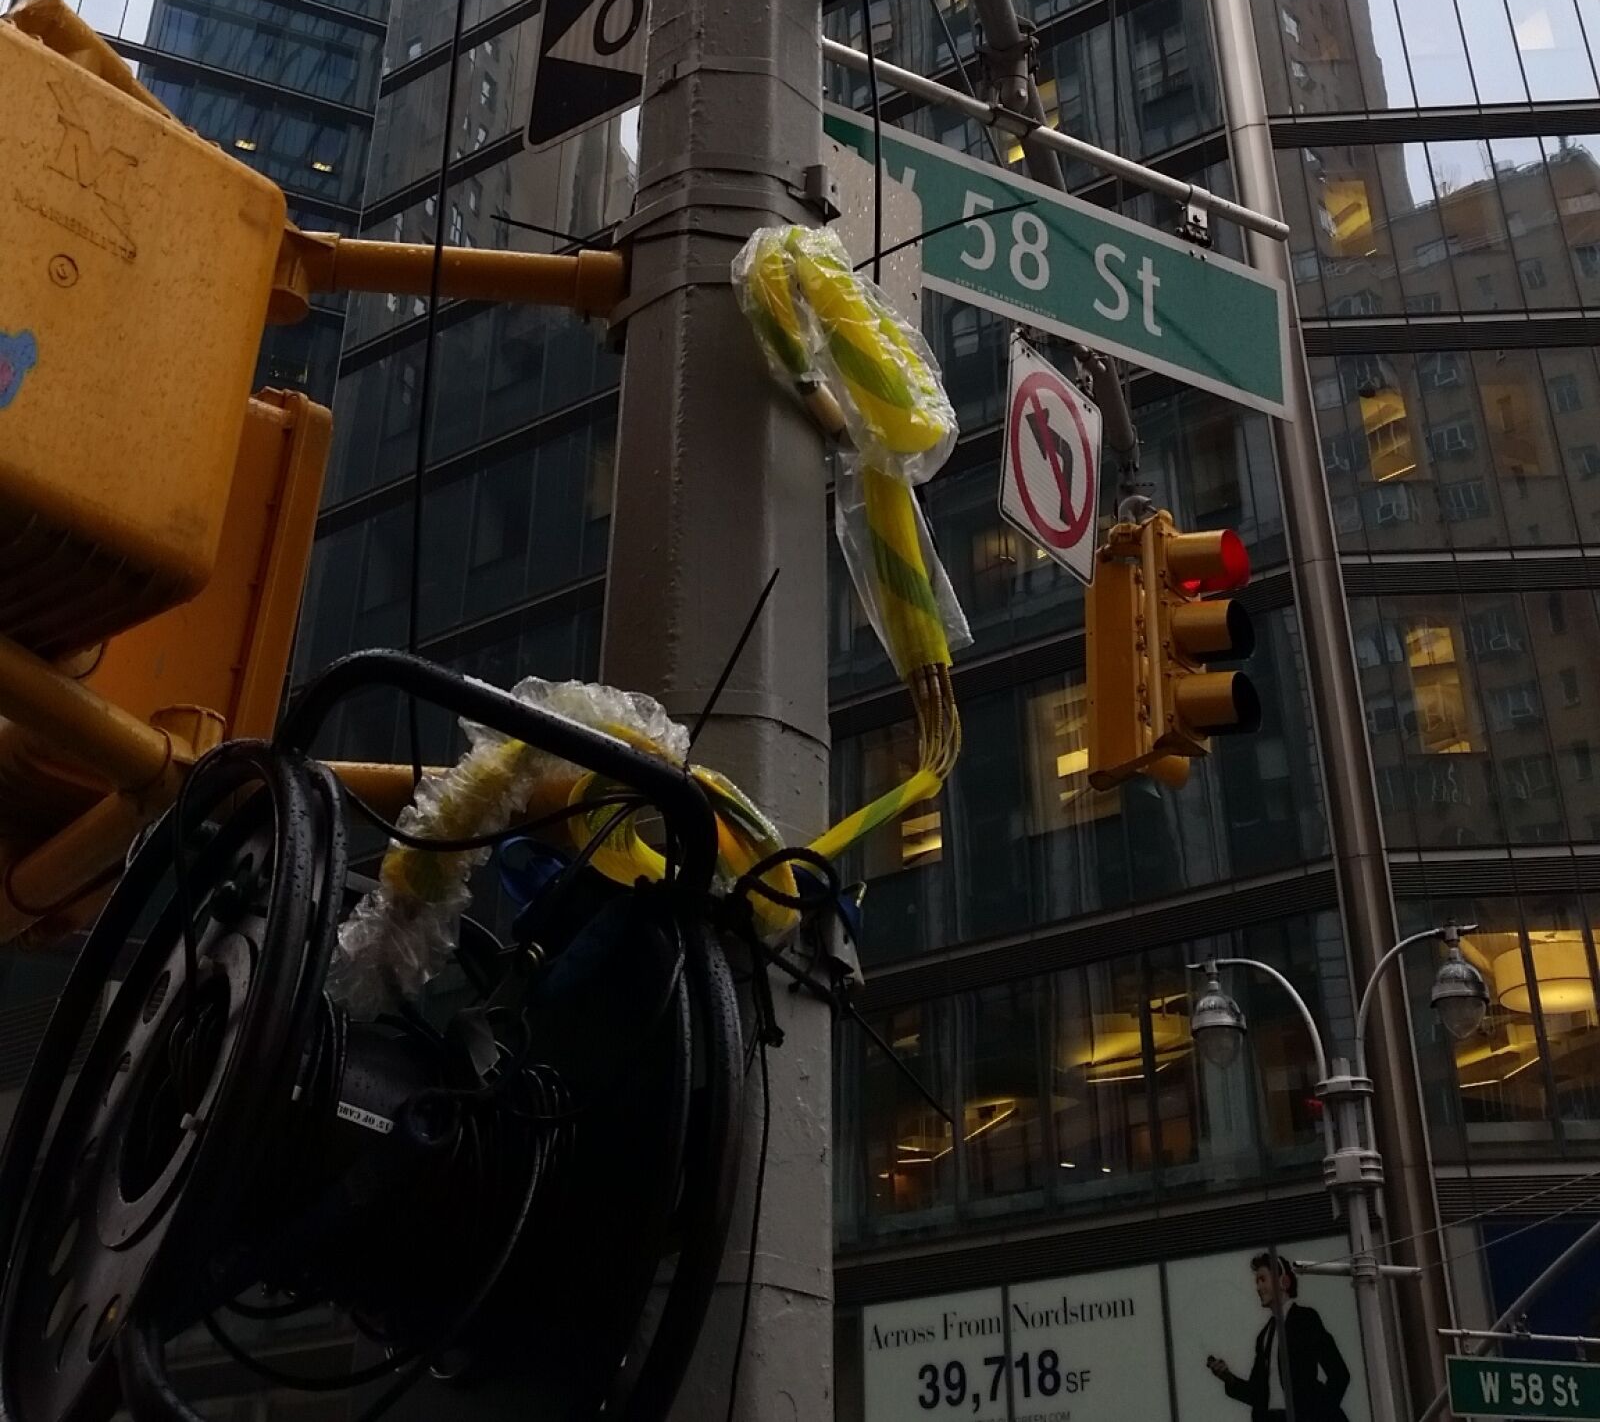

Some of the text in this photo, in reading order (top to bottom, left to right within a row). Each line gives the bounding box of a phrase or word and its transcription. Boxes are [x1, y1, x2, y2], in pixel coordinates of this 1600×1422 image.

[960, 190, 1162, 337] 58 St
[868, 1296, 1136, 1351] Across From Nordstrom
[917, 1349, 1092, 1414] 39,718 SF
[1479, 1371, 1580, 1407] W 58 St
